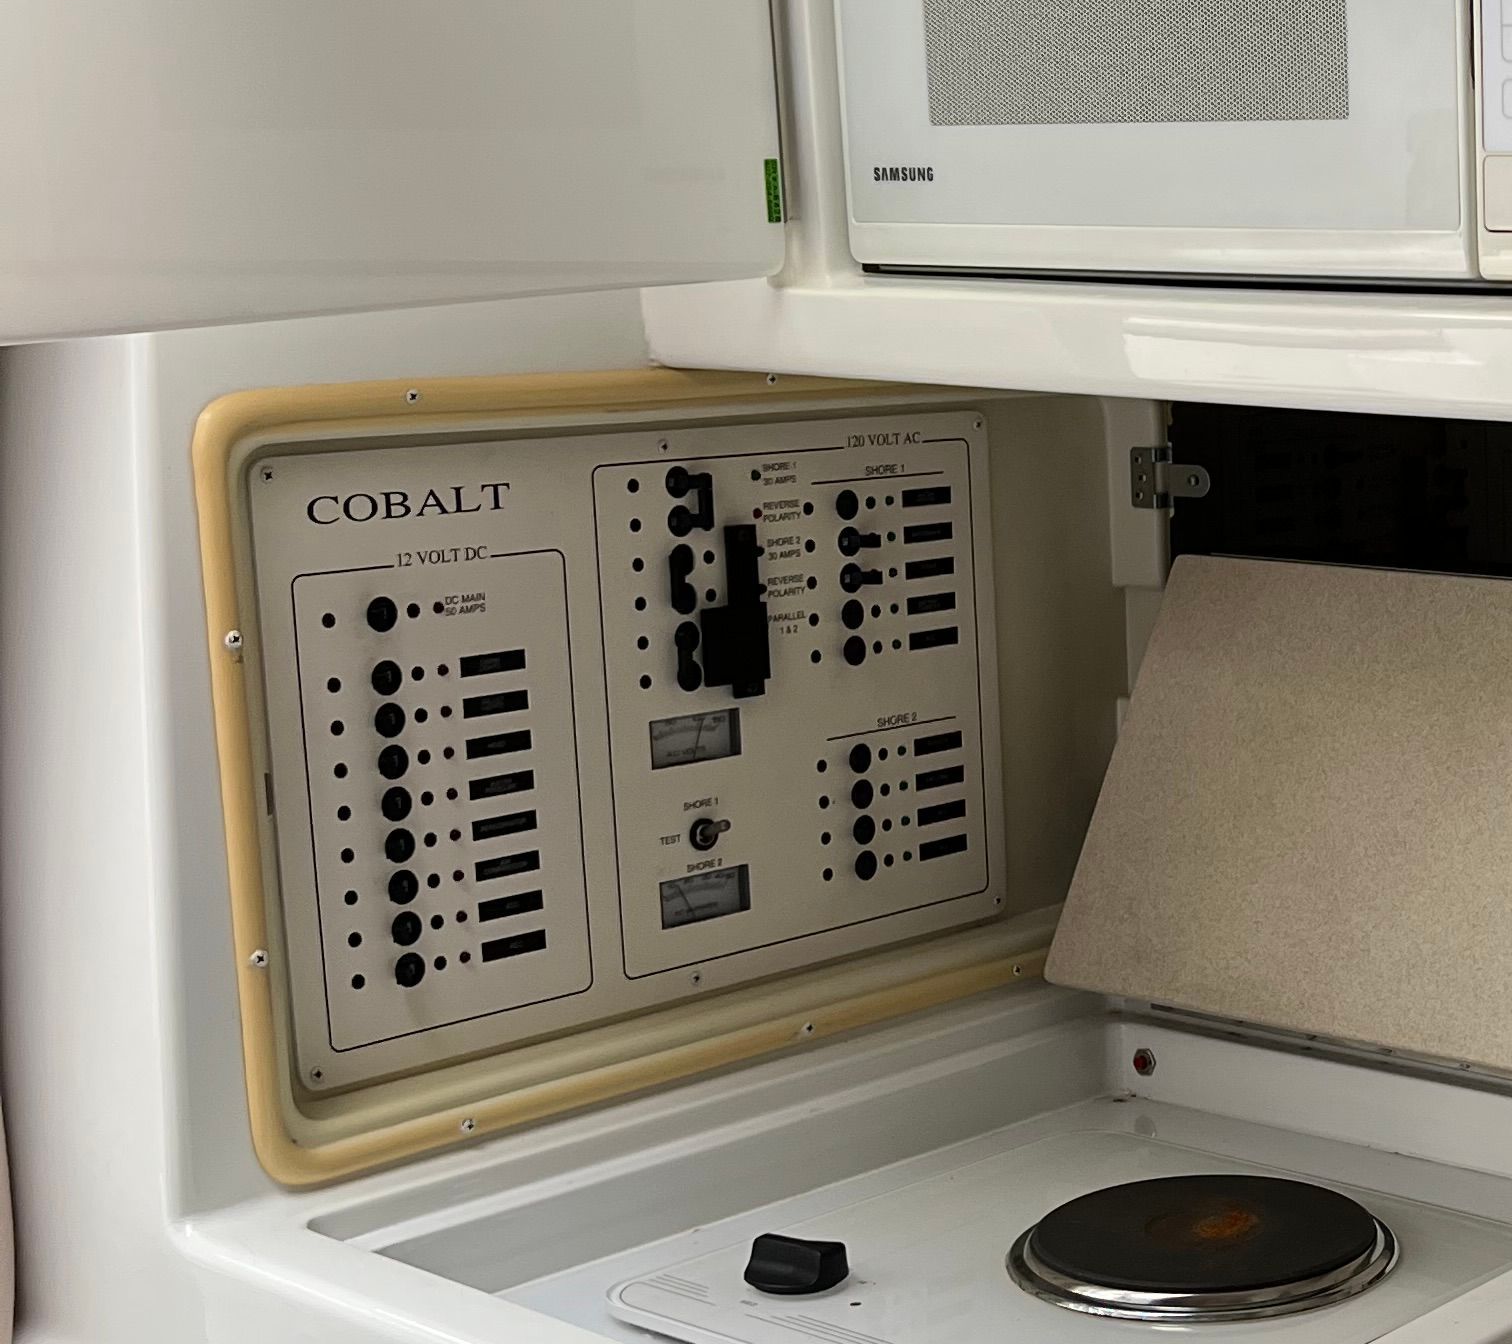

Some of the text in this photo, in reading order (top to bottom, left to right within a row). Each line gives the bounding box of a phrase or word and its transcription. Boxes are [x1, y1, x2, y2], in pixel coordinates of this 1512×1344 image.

[873, 166, 934, 182] SAMSUNG
[846, 431, 921, 449] 120 VOLT AC
[762, 462, 790, 473] SHORE
[864, 465, 898, 477] SHORE
[775, 475, 797, 485] AMPS
[306, 481, 511, 526] COBALT
[762, 499, 800, 511] REVERSE
[763, 511, 801, 523] POLARITY
[767, 536, 794, 548] SHORE
[397, 545, 488, 568] 12 VOLT DC
[779, 548, 801, 559] AMPS
[767, 574, 804, 586] REVERSE
[768, 586, 806, 598] POLARITY
[444, 592, 486, 605] DC MAIN
[459, 603, 486, 615] AMPS
[876, 714, 909, 728] SHORE
[683, 799, 712, 812] SHORE
[660, 834, 681, 846] TEST
[686, 859, 713, 873] SHORE
